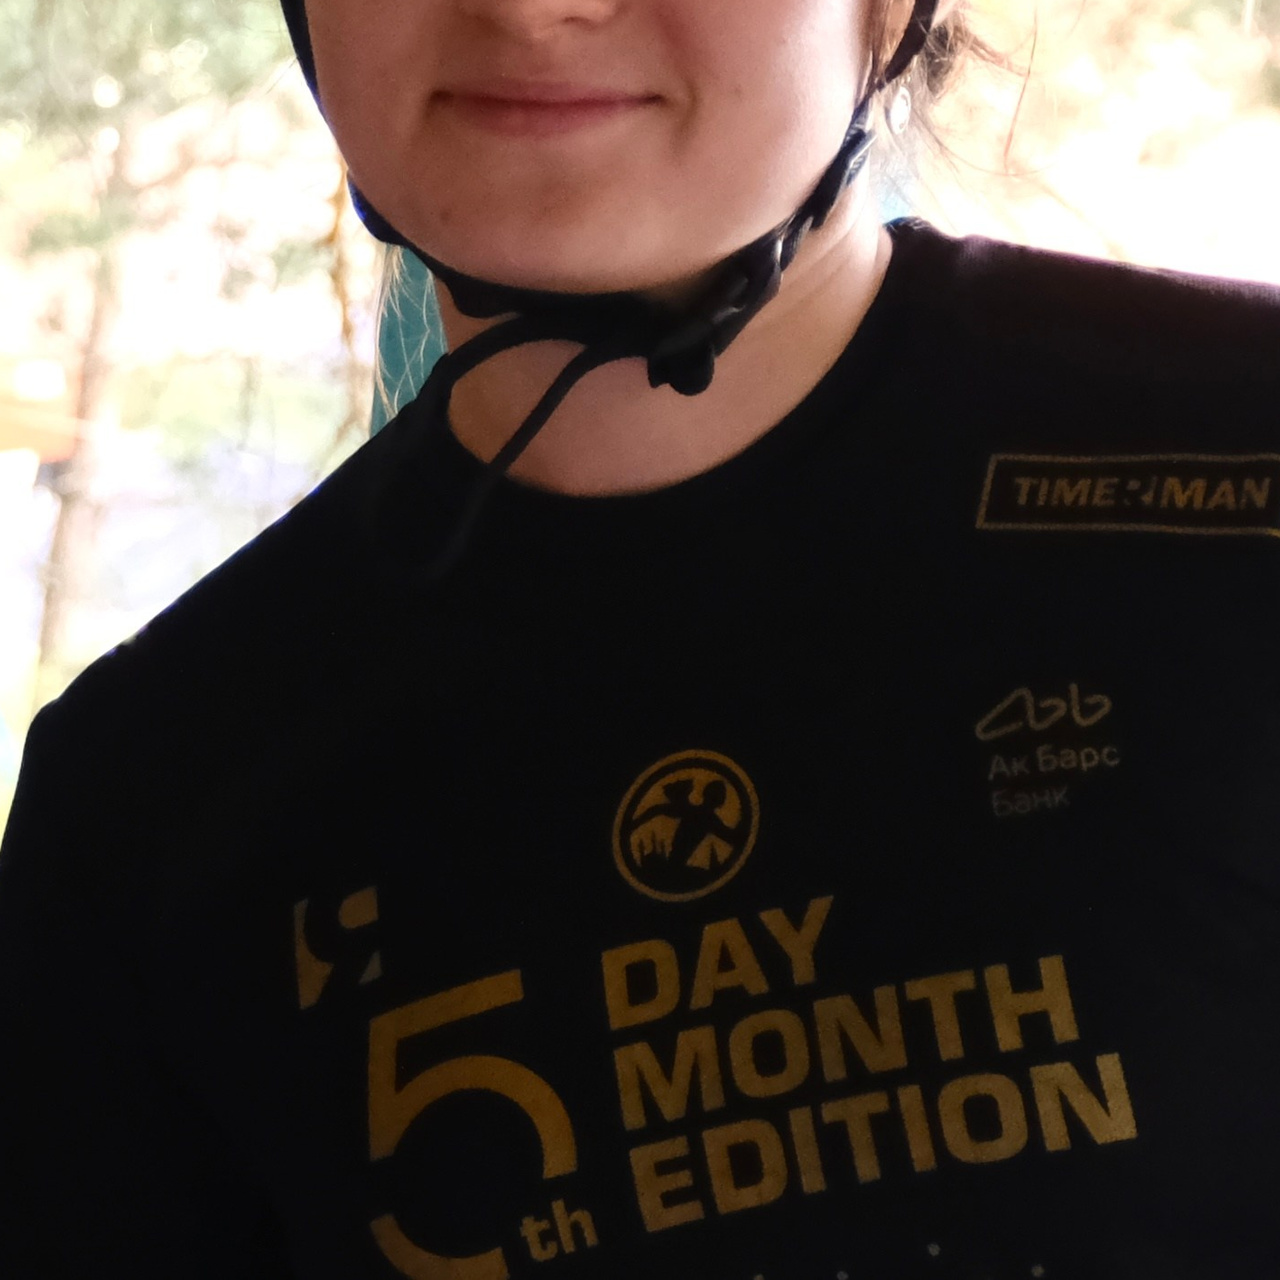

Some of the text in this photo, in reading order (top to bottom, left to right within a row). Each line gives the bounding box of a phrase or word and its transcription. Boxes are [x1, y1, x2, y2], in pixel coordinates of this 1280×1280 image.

[1034, 744, 1120, 773] Барс
[601, 894, 835, 1032] DAY
[612, 953, 1081, 1132] MONTH
[628, 1051, 1139, 1234] EDITION
